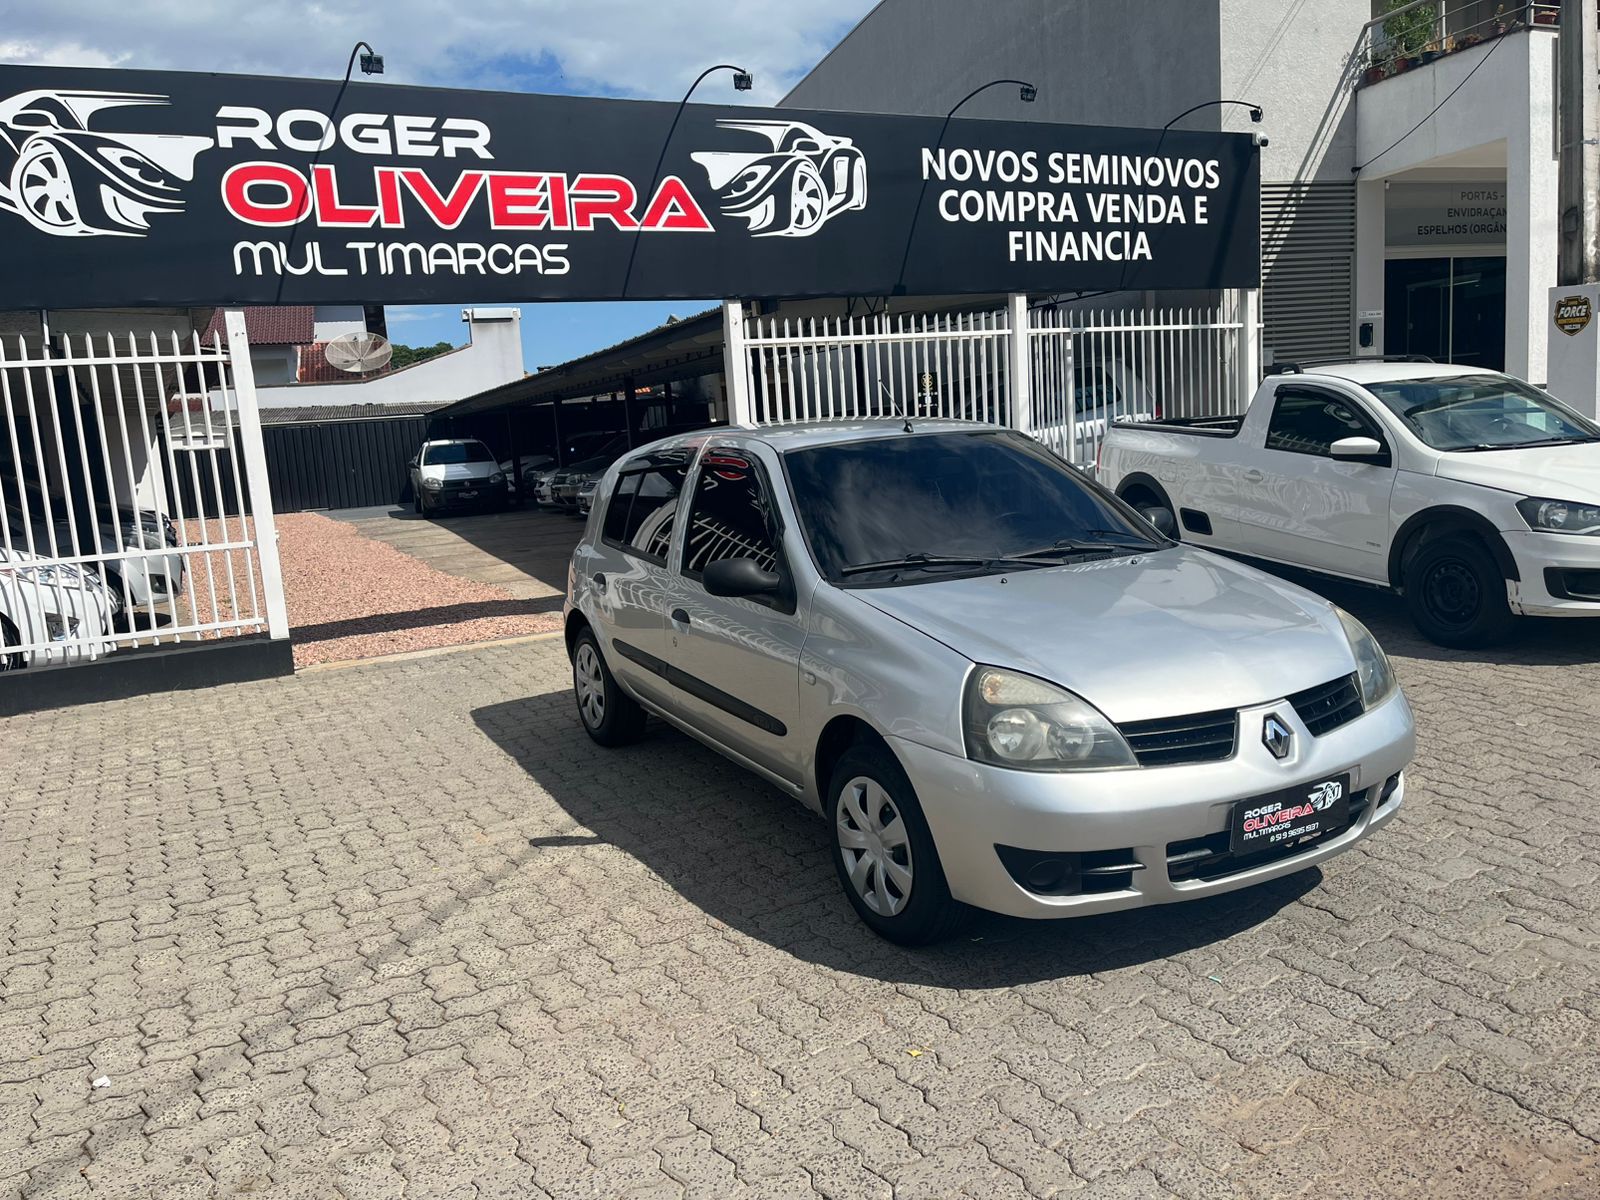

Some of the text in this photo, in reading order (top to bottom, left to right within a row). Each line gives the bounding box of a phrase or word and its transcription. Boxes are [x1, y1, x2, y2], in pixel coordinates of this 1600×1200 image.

[216, 105, 494, 159] ROGER
[922, 147, 1220, 189] NOVOS SEMINOVOS
[221, 161, 715, 232] OLIVEIRA
[938, 189, 1209, 225] COMPRA VENDA E
[1460, 191, 1498, 201] PORTAS
[1417, 224, 1468, 236] ESPELHOS
[234, 240, 570, 276] MULTIMARCAS
[1008, 230, 1153, 262] FINANCIA
[1558, 304, 1588, 318] FORCE
[1243, 802, 1282, 819] ROGER
[1243, 803, 1315, 832] OLIVEIRA
[1243, 821, 1292, 840] MULTIMARCAS
[1282, 831, 1288, 840] 9
